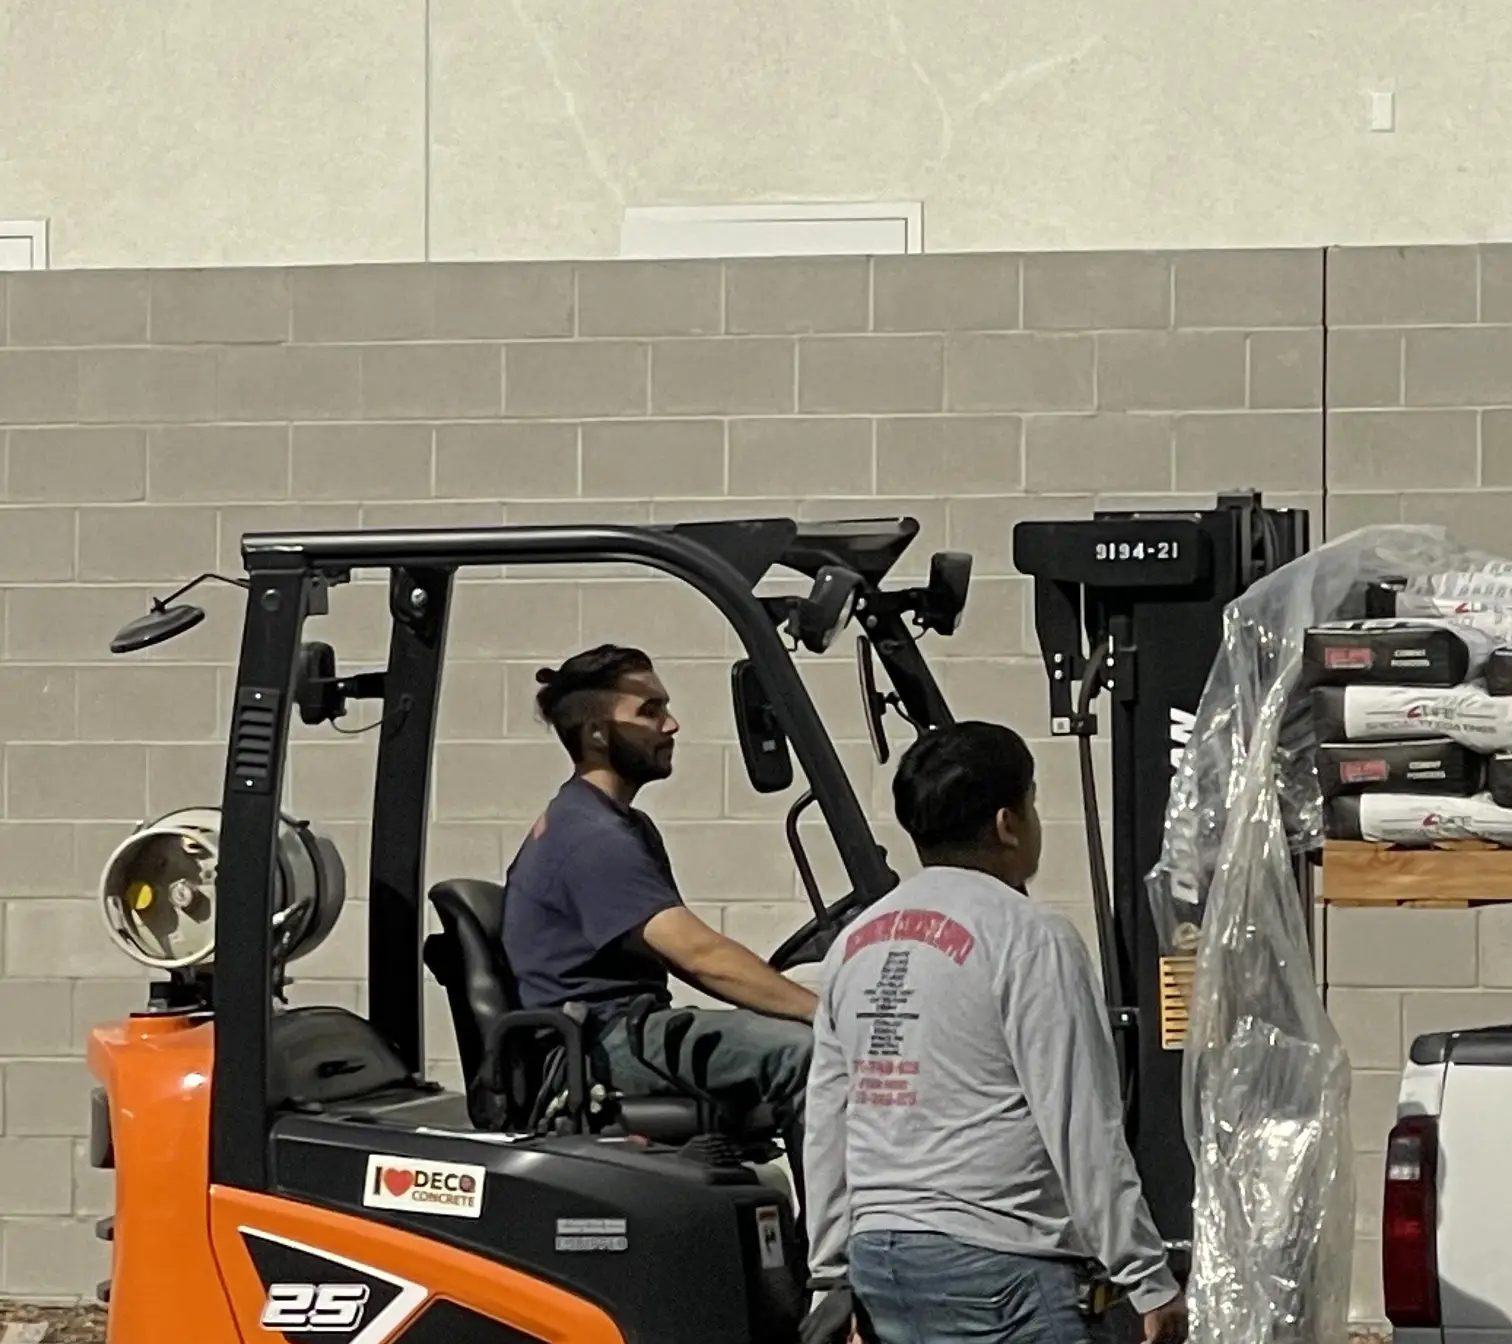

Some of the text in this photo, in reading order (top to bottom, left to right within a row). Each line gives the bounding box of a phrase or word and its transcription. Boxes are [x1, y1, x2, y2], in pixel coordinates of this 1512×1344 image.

[1095, 542, 1178, 560] 9194-21
[412, 1190, 475, 1207] CONCRETE
[260, 1283, 370, 1333] 25
